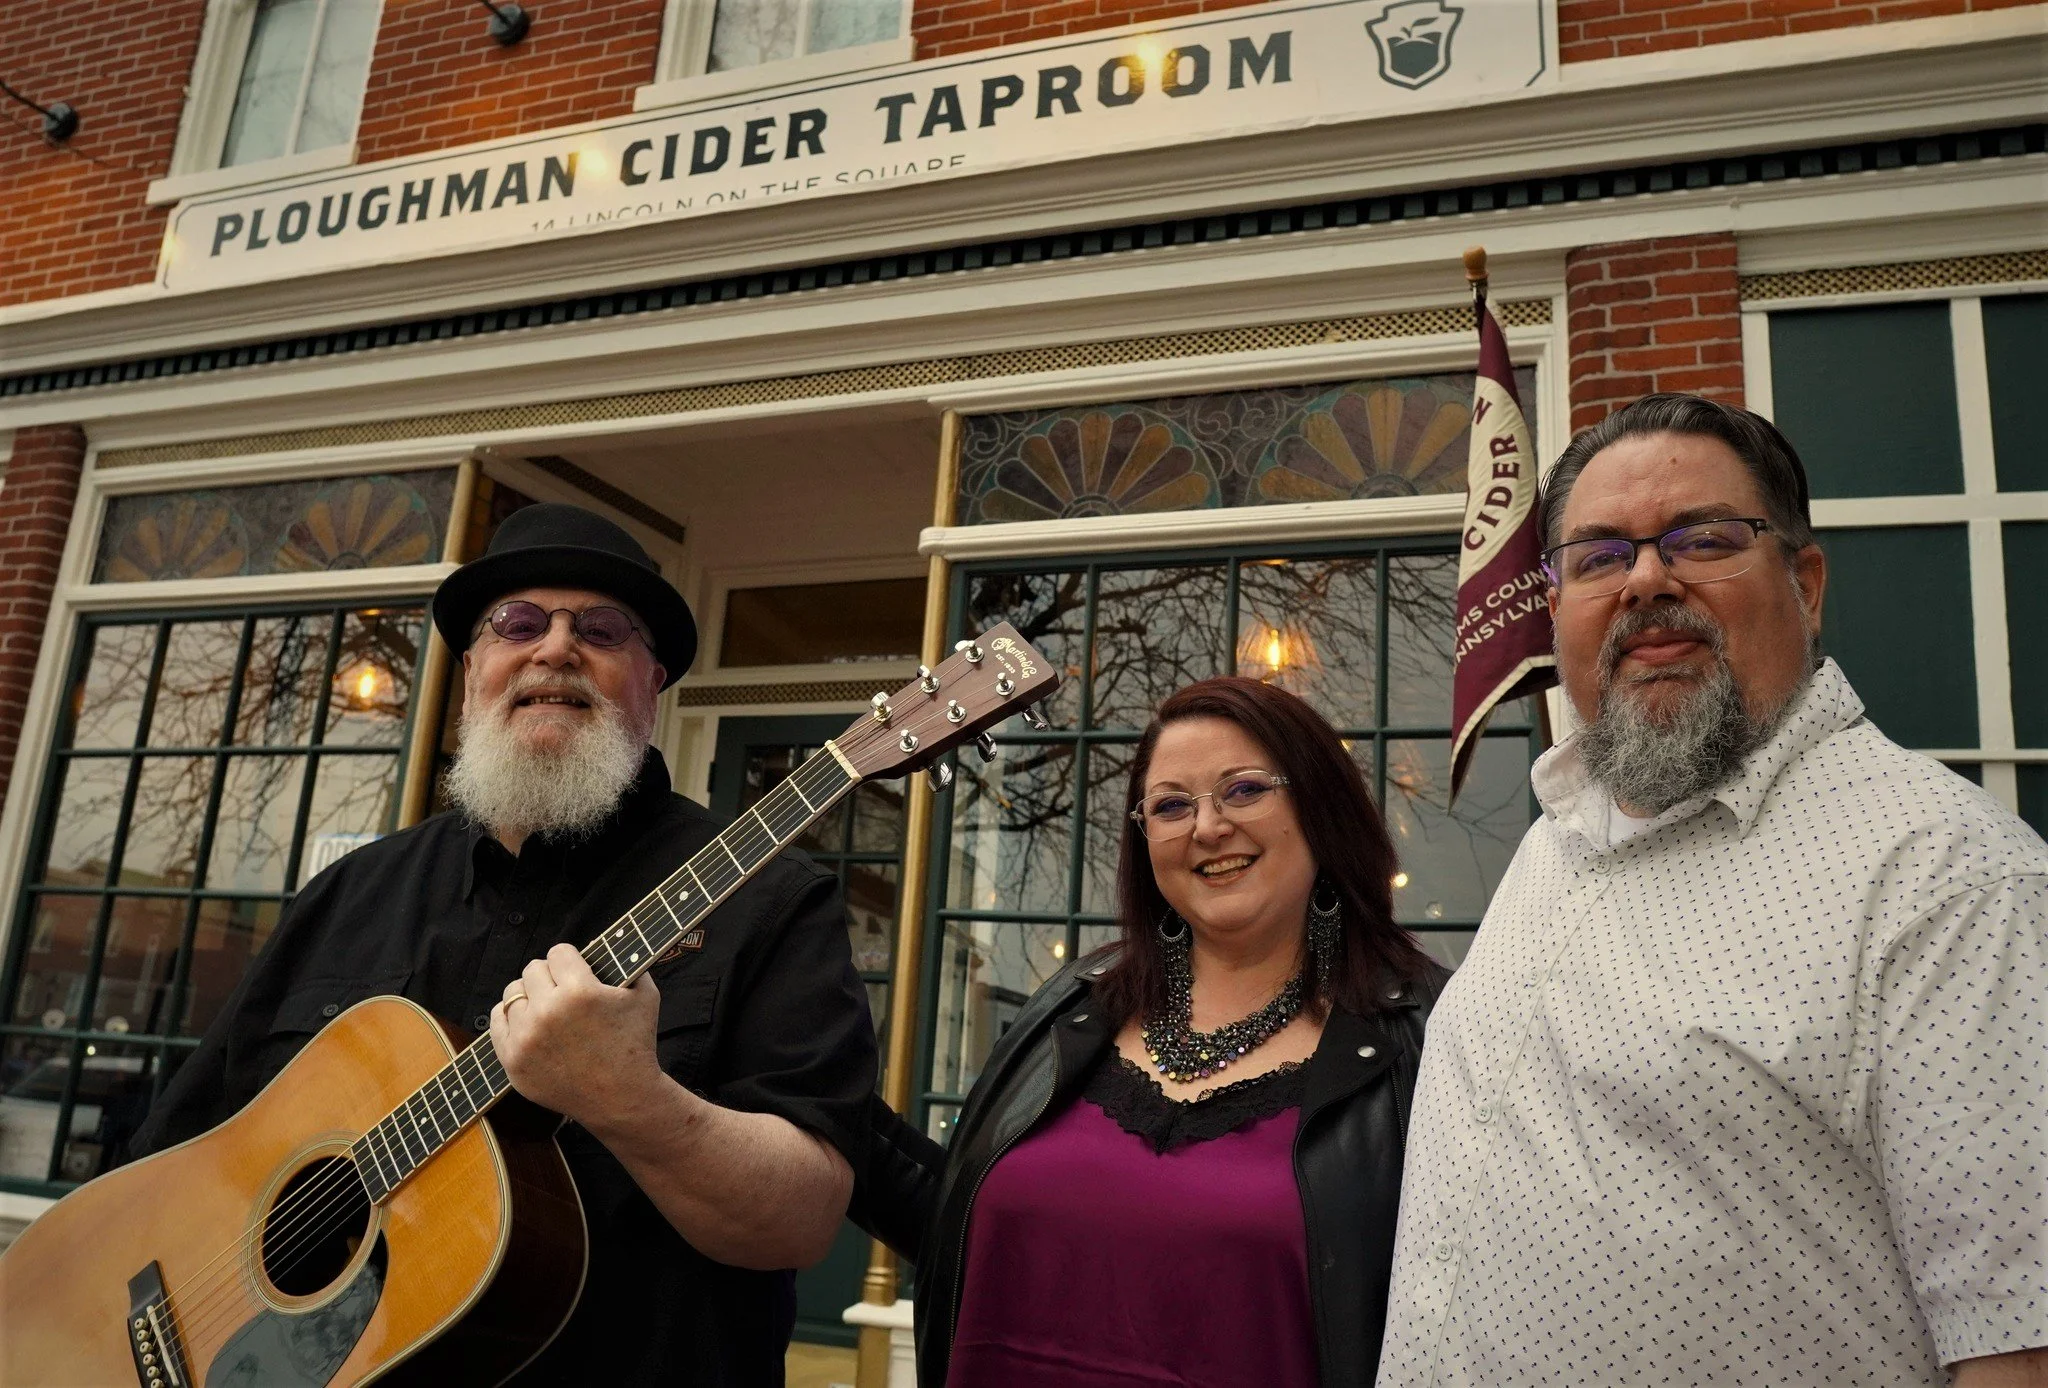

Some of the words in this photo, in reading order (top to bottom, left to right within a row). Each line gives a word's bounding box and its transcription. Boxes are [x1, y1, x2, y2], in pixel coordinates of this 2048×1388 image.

[211, 152, 578, 256] PLOUGHMAN
[619, 108, 828, 188] CIDER
[876, 32, 1292, 143] TAPROOM
[1463, 433, 1520, 551] CIDER
[1455, 594, 1549, 664] NNSYLVA
[1456, 606, 1483, 637] MS
[1485, 568, 1547, 609] COUN
